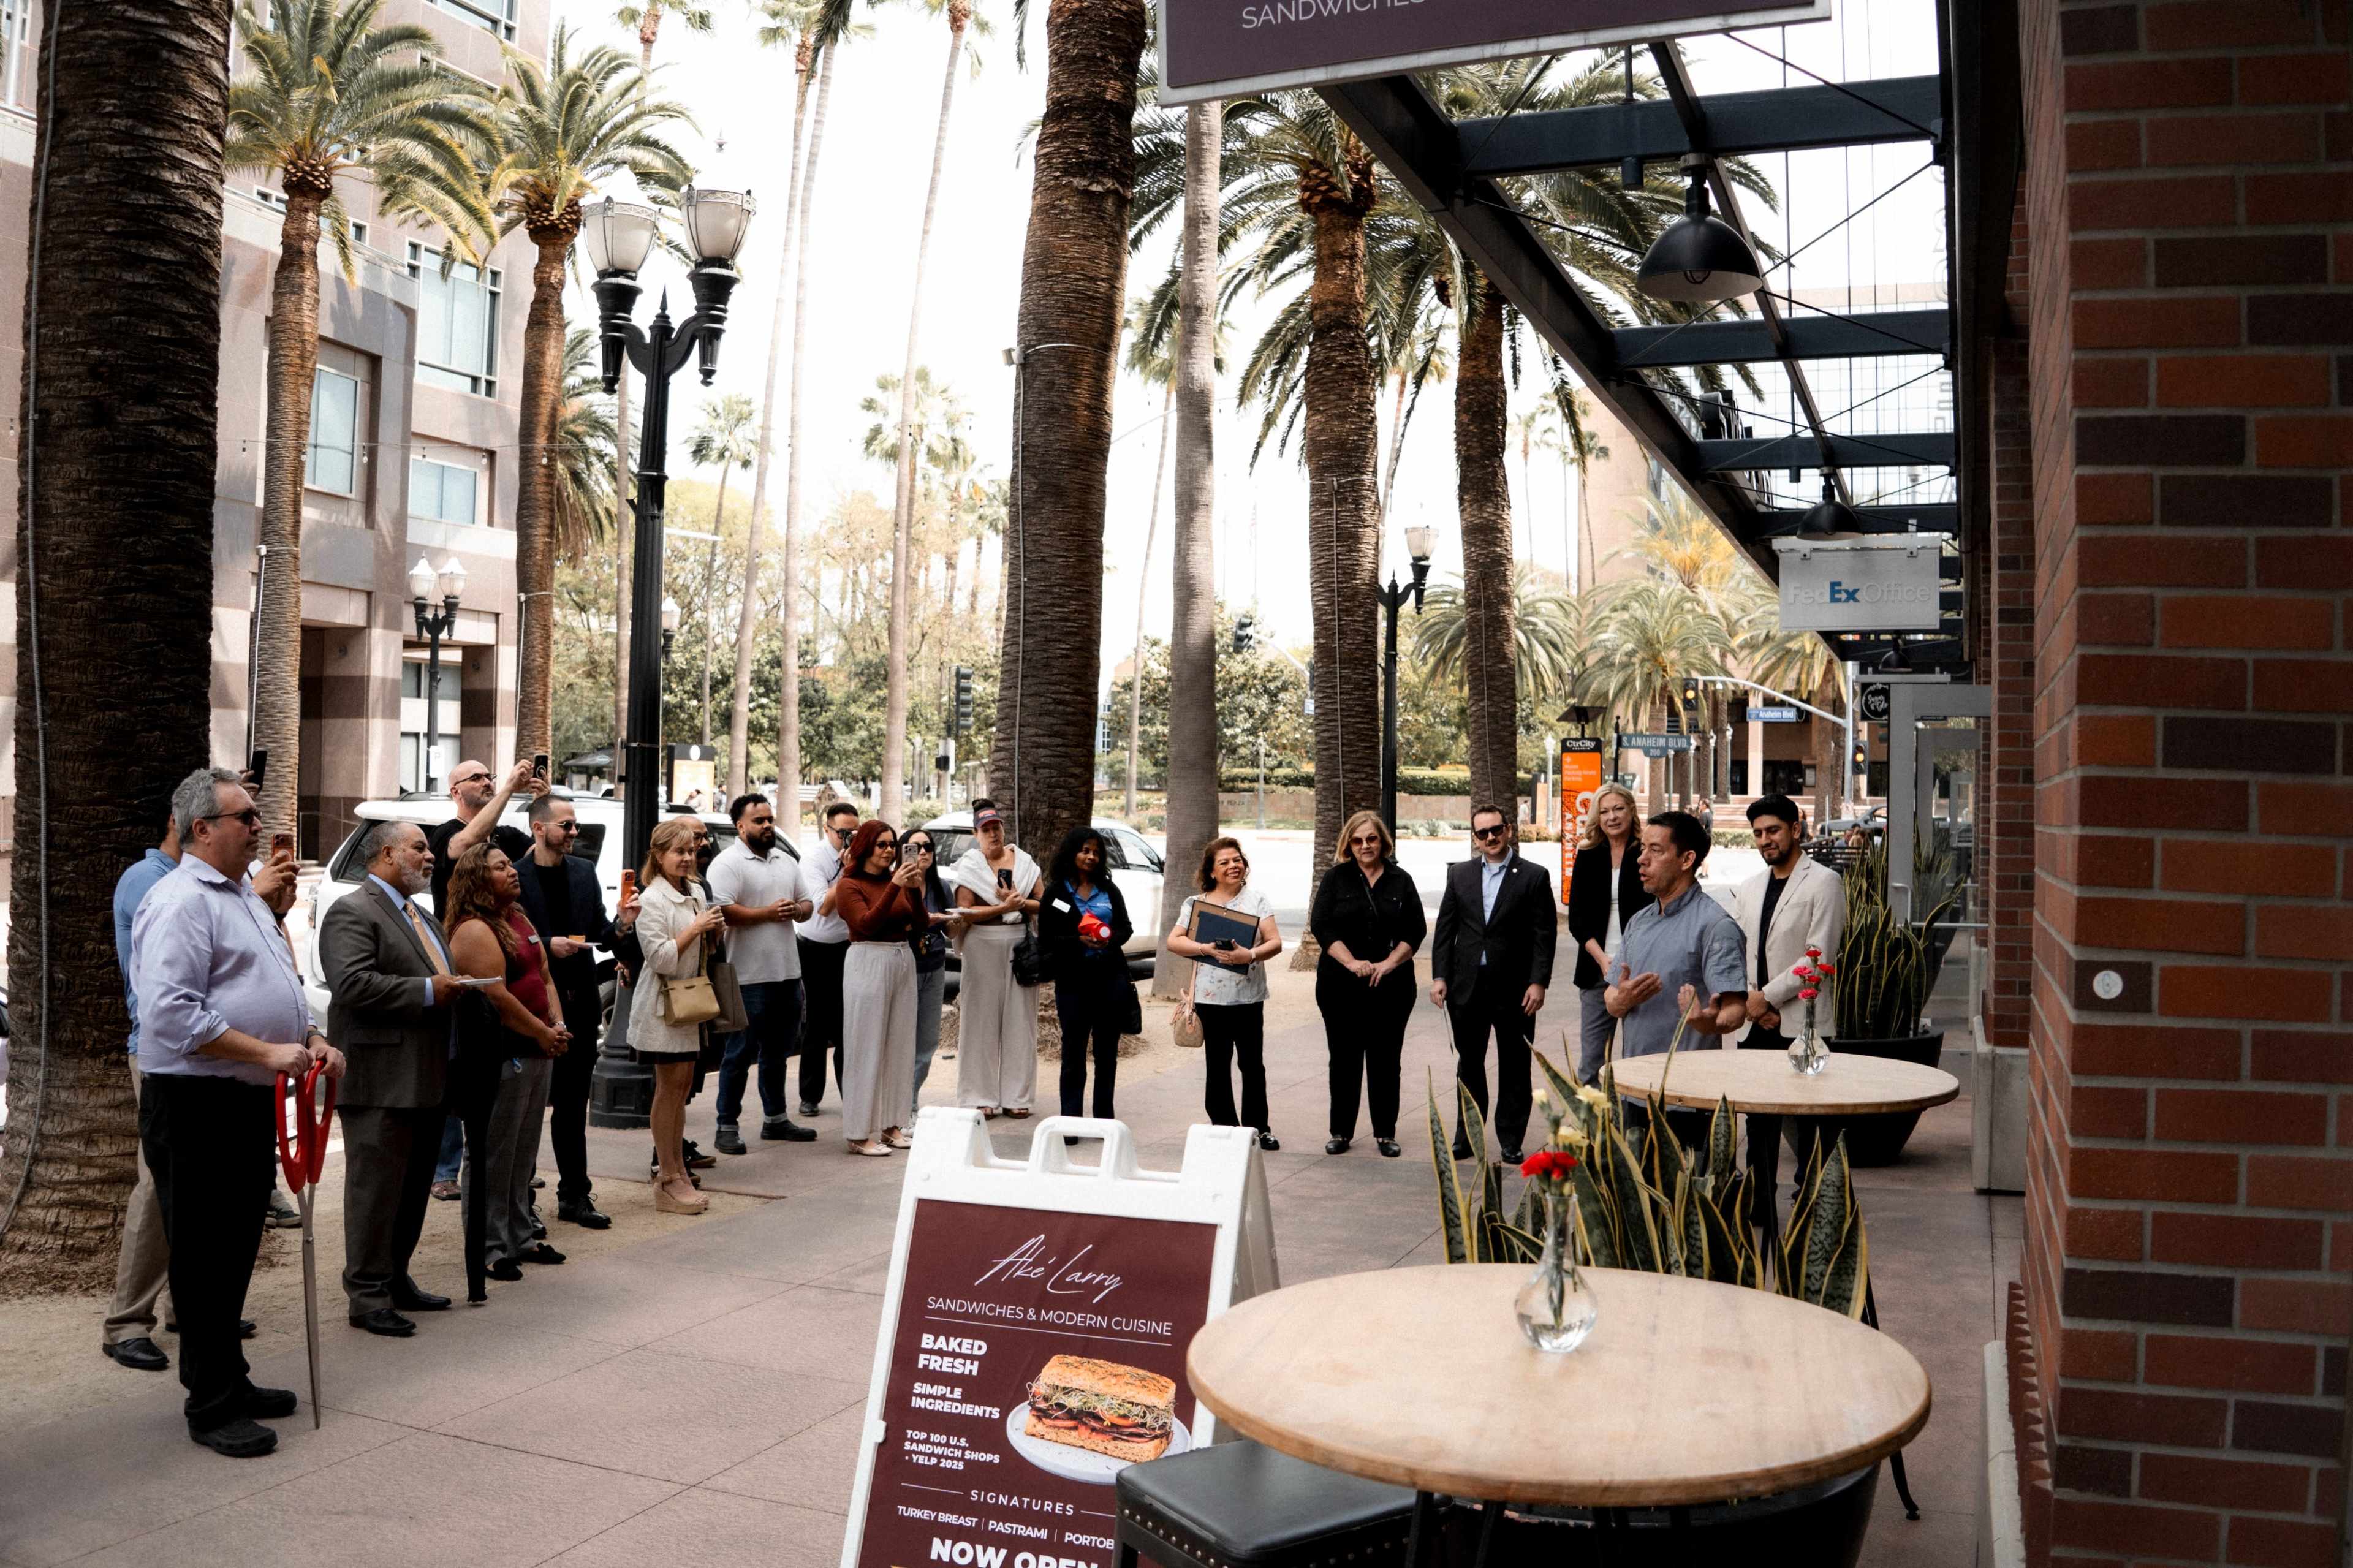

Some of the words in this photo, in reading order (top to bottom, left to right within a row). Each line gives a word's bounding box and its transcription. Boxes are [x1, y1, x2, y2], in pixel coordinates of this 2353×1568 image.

[1242, 0, 1425, 28] SANDWIC
[1787, 581, 1860, 604] FedEx
[1863, 582, 1930, 603] Office
[1759, 710, 1782, 719] Anaheim
[1566, 740, 1596, 748] CtrCity
[1622, 737, 1629, 746] S.
[1631, 737, 1666, 747] ANAHEIM
[1669, 737, 1688, 748] BLVD.
[1564, 812, 1574, 877] ANAHEIM
[1047, 1244, 1123, 1304] Larry
[926, 1296, 1023, 1319] SANDWICHES
[1027, 1308, 1037, 1320] &
[1040, 1309, 1107, 1329] MODERN
[1112, 1317, 1172, 1335] CUISINE
[920, 1333, 987, 1355] BAKED
[917, 1354, 979, 1376] FRESH
[913, 1382, 962, 1399] SIMPLE
[911, 1396, 1001, 1419] INGREDIENTS
[906, 1430, 927, 1440] TOP
[930, 1433, 947, 1444] 100
[950, 1436, 969, 1447] U.S.
[904, 1441, 962, 1458] SANDWICH
[964, 1450, 1000, 1463] SHOPS
[912, 1454, 938, 1465] YELP
[939, 1458, 964, 1470] 2025
[970, 1490, 1074, 1515] SIGNATURES
[897, 1505, 936, 1520] TURKEY
[938, 1512, 978, 1527] BREAST
[988, 1520, 1048, 1539] PASTRAMI
[930, 1537, 1008, 1568] NOW
